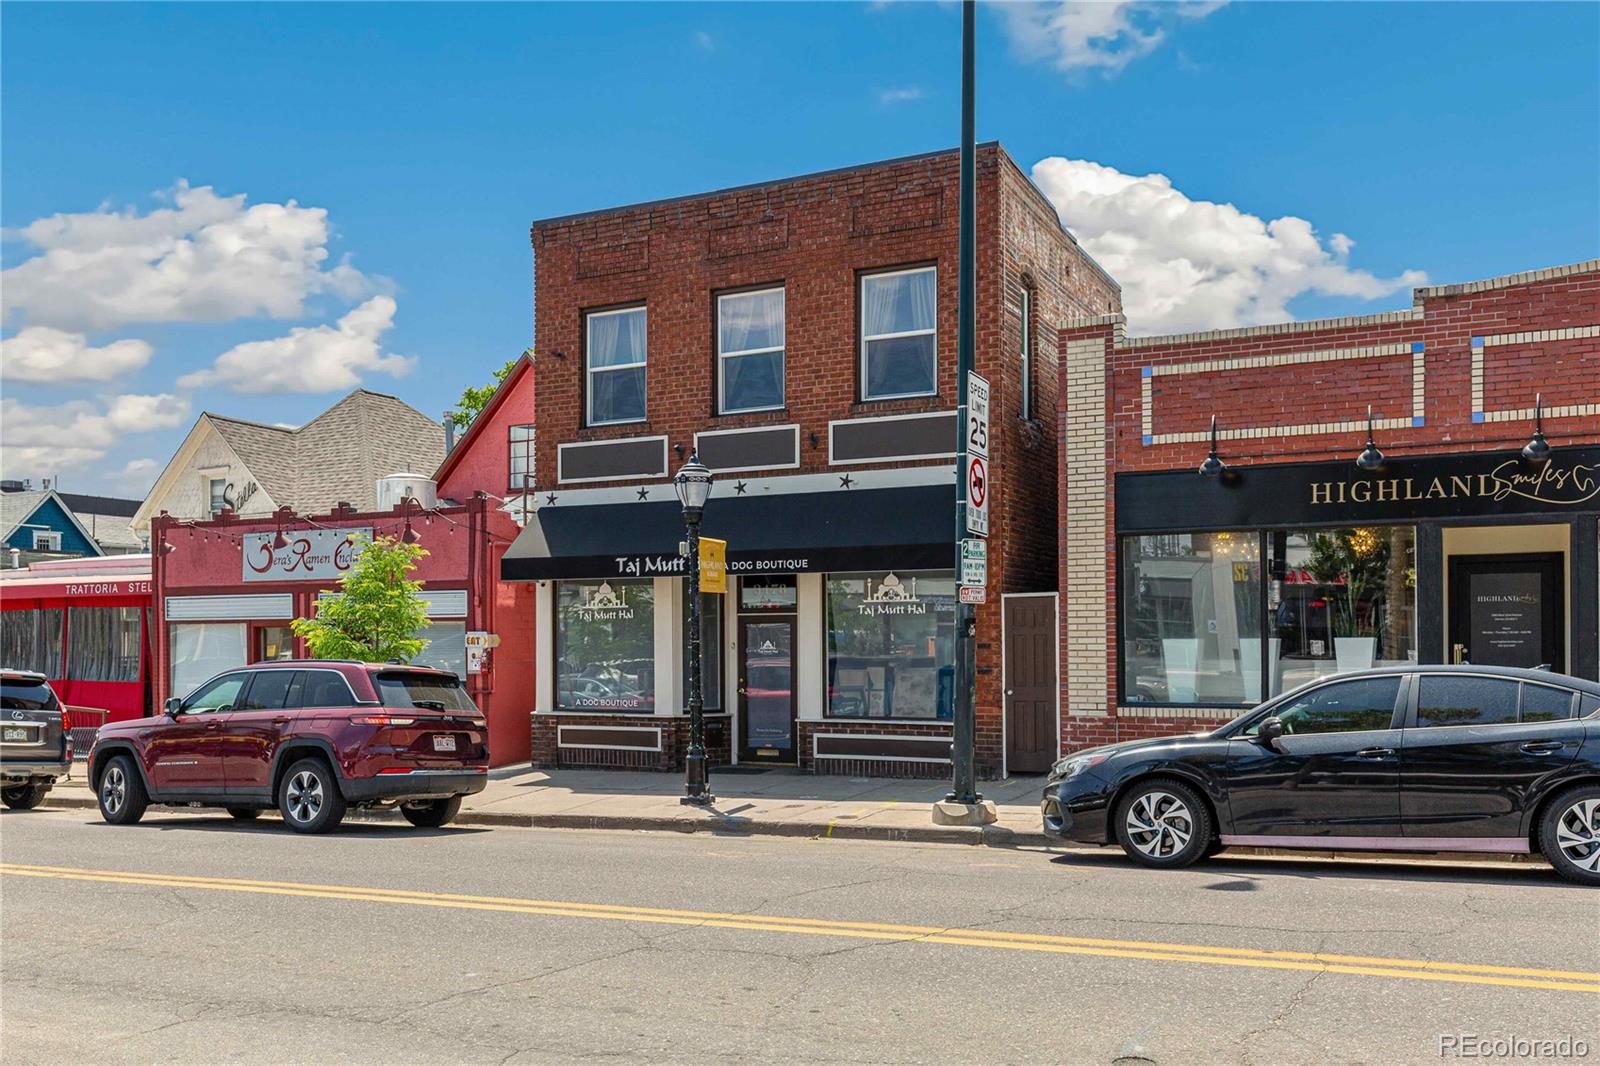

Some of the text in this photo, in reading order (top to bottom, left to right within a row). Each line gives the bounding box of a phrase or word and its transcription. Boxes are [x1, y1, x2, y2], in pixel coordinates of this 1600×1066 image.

[970, 382, 987, 401] SPEED
[971, 399, 986, 416] LIMIT
[970, 417, 986, 449] 25
[1310, 459, 1571, 504] HIGHLAND Smiles
[223, 483, 259, 513] Stella
[283, 538, 332, 572] Ramen
[334, 537, 361, 571] Encla
[963, 542, 969, 557] 2
[615, 557, 641, 577] Taj
[645, 556, 686, 573] Mutt
[731, 561, 754, 570] DOG
[756, 559, 809, 570] BOUTIQUE
[65, 582, 152, 595] TRATTORIA STEL
[578, 608, 634, 622] Taj Mutt Hal
[858, 603, 926, 617] Taj Mutt Hal
[466, 636, 480, 645] EAT
[600, 699, 639, 708] BOUTIQUE
